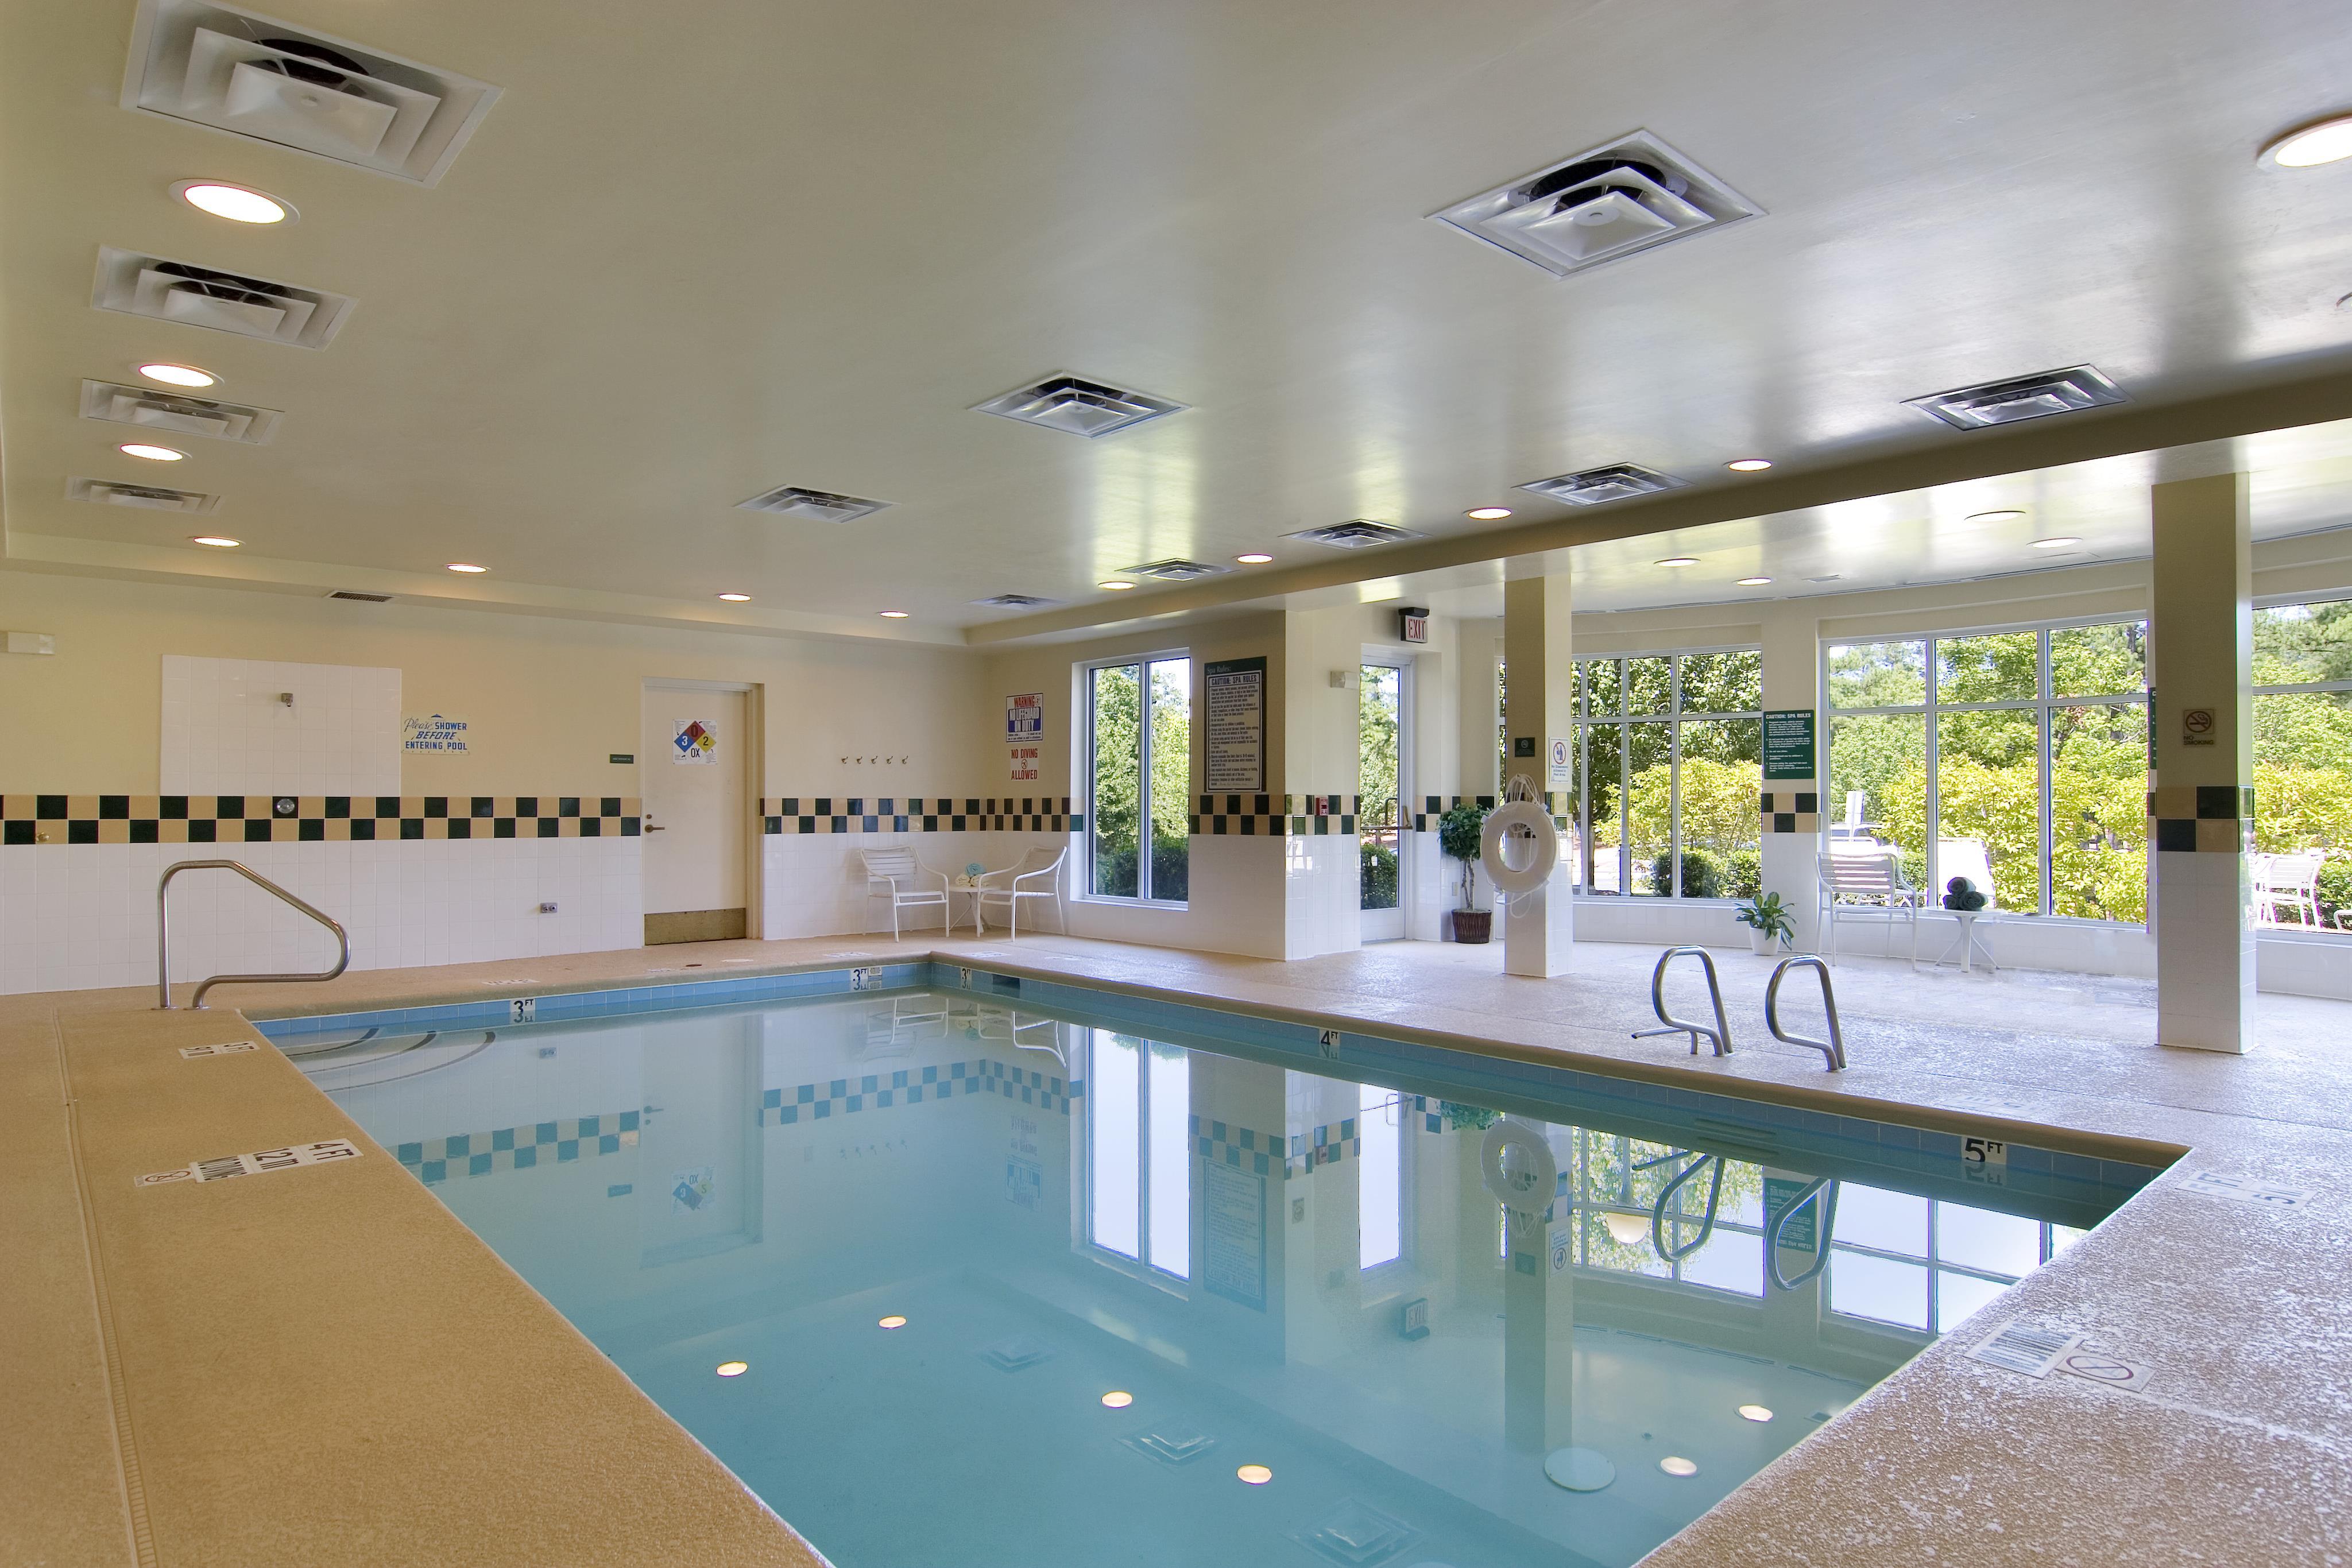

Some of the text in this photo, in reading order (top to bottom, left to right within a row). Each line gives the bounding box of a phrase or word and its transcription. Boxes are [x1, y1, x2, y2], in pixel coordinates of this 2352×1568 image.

[1408, 618, 1425, 640] EXIT
[1243, 675, 1256, 683] RULES
[1013, 696, 1035, 708] WARNING
[1009, 707, 1040, 721] NO LIFEGUARD
[435, 722, 467, 730] SHOWER
[1014, 719, 1034, 732] ON DUTY
[416, 731, 457, 740] BEFORE
[681, 735, 688, 746] 3
[703, 736, 709, 746] 2
[405, 741, 467, 750] ENTERING POOL
[1011, 748, 1038, 759] NO DIVING
[1011, 770, 1038, 780] ALLOWED
[514, 1000, 523, 1012] 3
[1321, 1030, 1338, 1045] 4 FT
[308, 1143, 354, 1160] 4 FT
[1965, 1139, 2003, 1163] 5 FT
